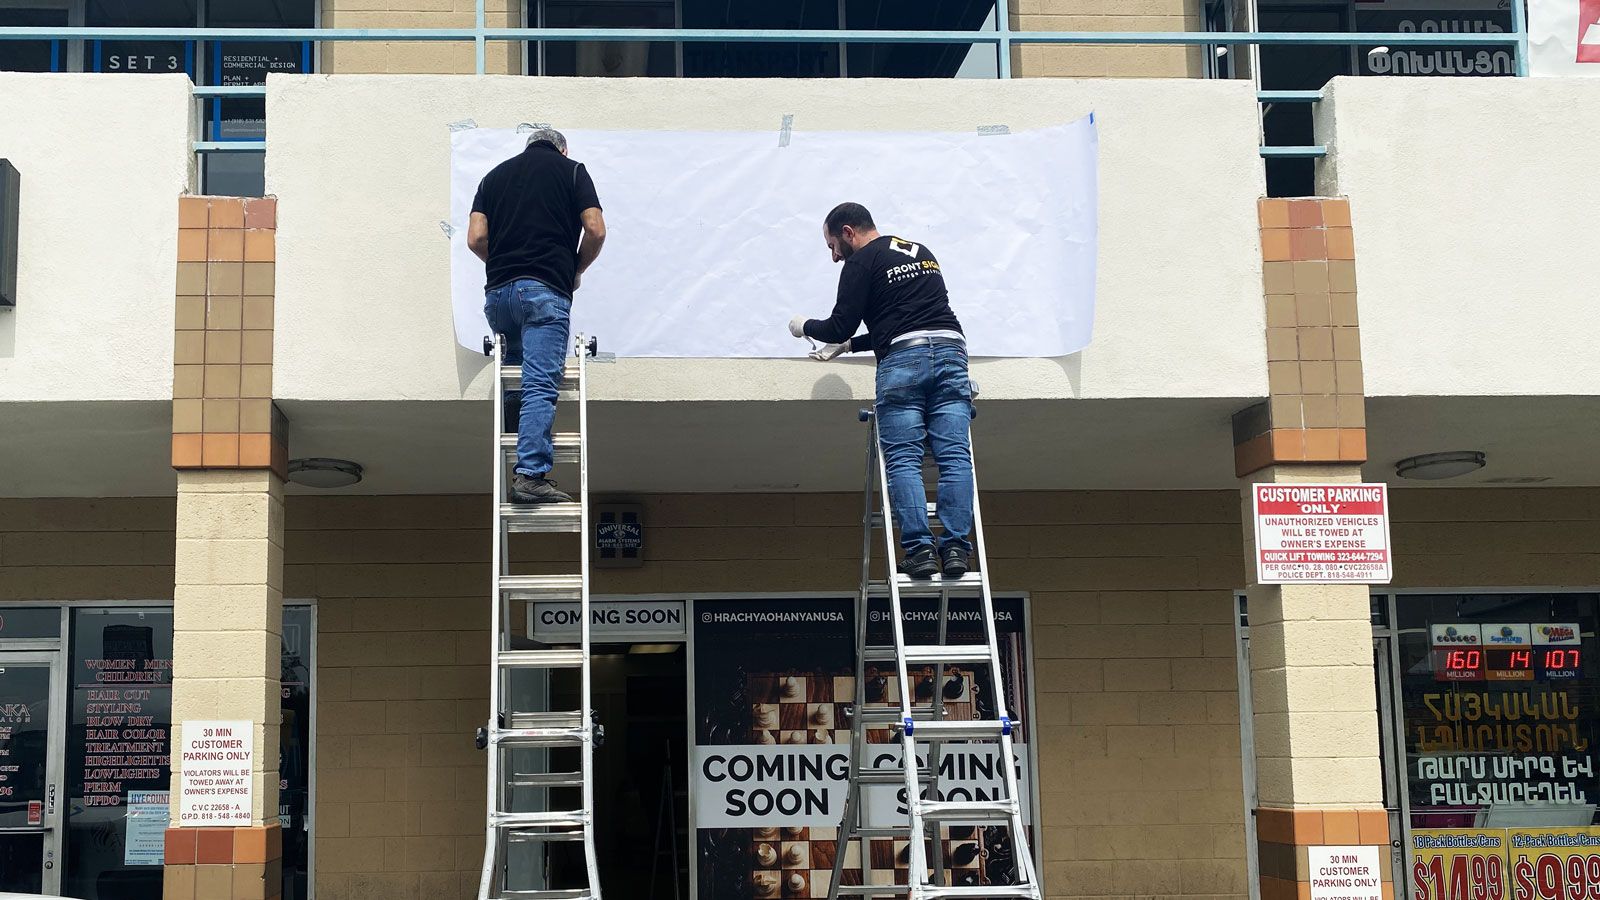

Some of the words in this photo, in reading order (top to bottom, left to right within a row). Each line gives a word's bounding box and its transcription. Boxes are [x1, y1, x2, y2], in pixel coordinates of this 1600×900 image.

[109, 56, 155, 70] SET
[168, 56, 178, 70] 3
[1260, 488, 1325, 502] CUSTOMER
[1328, 488, 1380, 502] PARKING
[1301, 504, 1340, 514] ONLY
[1336, 518, 1378, 526] VEHICLES
[599, 524, 640, 535] UNIVERSAL
[1280, 540, 1322, 548] OWNER'S
[1324, 540, 1366, 548] EXPENSE
[1264, 552, 1288, 561] QUICK
[1290, 552, 1304, 560] LIFT
[1306, 552, 1336, 560] TOWING
[1338, 552, 1384, 560] 323-644-7294
[625, 609, 680, 624] SOON
[714, 612, 844, 622] HRACHYAOHANYANUSA
[1446, 650, 1480, 669] 160
[1510, 650, 1530, 668] 14
[1545, 650, 1580, 668] 107
[85, 660, 136, 669] WOMEN
[144, 660, 173, 669] MEN
[96, 672, 162, 681] CHILDREN
[88, 690, 120, 700] HAIR
[124, 690, 150, 700] CUT
[86, 703, 141, 713] STYLING
[1424, 692, 1578, 721] ՀԱՅԿԱԿԱՆ
[86, 716, 124, 726] BLOW
[128, 716, 154, 726] DRY
[86, 730, 119, 739] HAIR
[122, 729, 166, 739] COLOR
[203, 729, 213, 737] 30
[216, 728, 232, 736] MIN
[86, 742, 164, 752] TREATMENT
[192, 740, 243, 749] CUSTOMER
[226, 752, 250, 760] ONLY
[702, 754, 849, 782] COMING
[1418, 756, 1486, 780] ԹԱՐՄ
[1493, 756, 1556, 779] ՄԻՐԳ
[84, 769, 160, 779] LOWLIGHTS
[84, 782, 121, 792] PERM
[84, 795, 120, 805] UPDO
[725, 788, 829, 816] SOON
[1446, 835, 1500, 848] Bottles/Cans
[1512, 835, 1546, 848] 12-Pack
[1548, 835, 1600, 848] Bottles/Cans
[1342, 855, 1358, 863] MIN
[1320, 867, 1369, 875] CUSTOMER
[1354, 879, 1377, 887] ONLY
